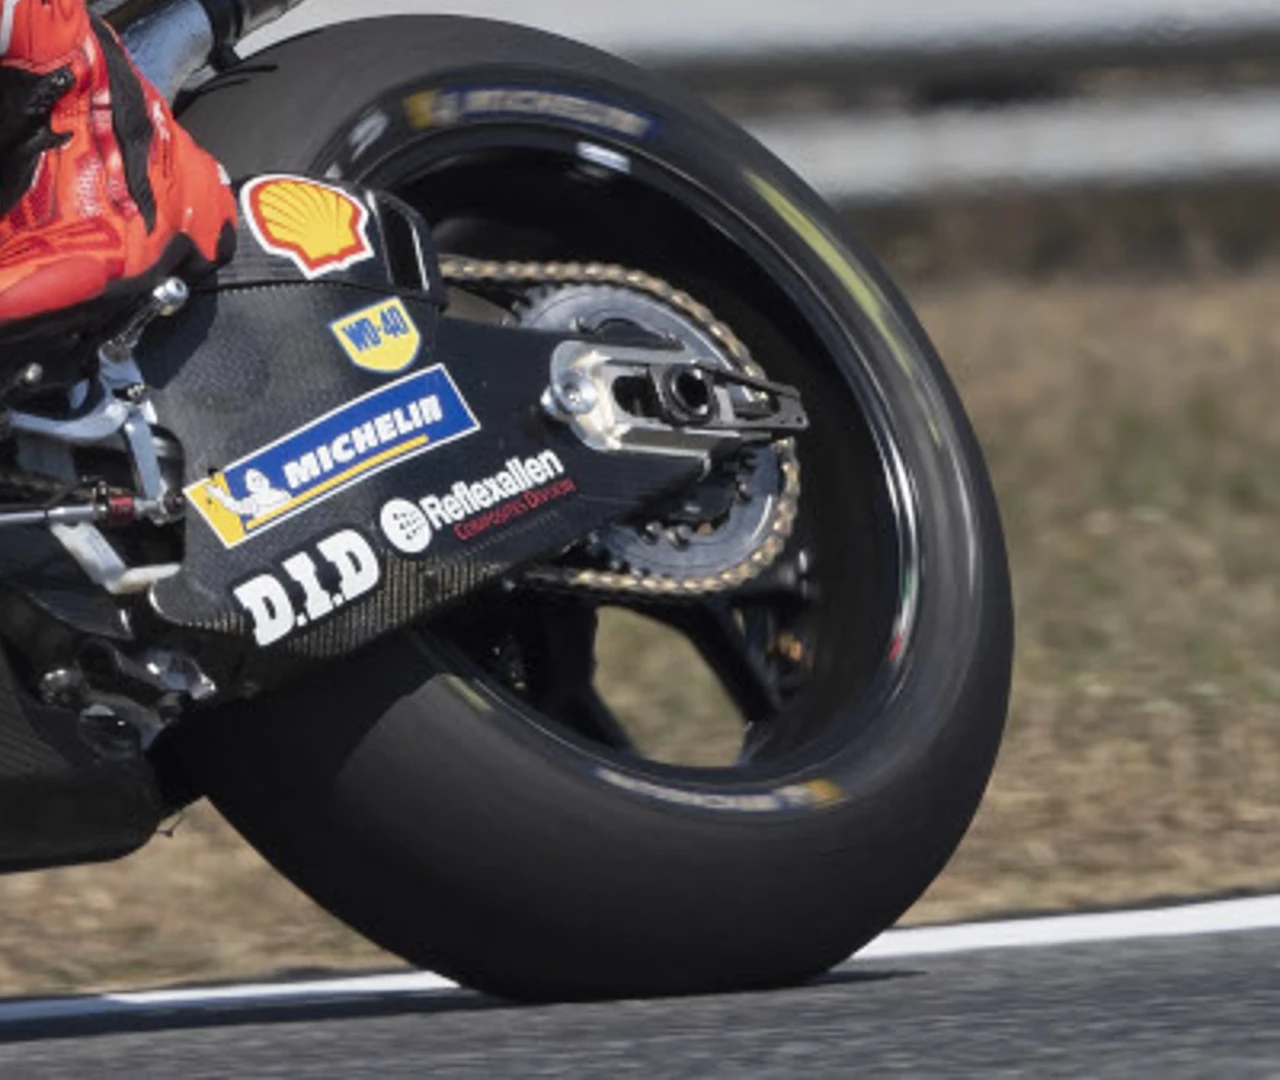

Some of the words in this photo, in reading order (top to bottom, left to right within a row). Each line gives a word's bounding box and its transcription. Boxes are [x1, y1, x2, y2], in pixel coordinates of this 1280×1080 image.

[341, 304, 409, 353] WD-40
[282, 394, 443, 489] MICHELIN
[419, 448, 565, 531] Reflexallen
